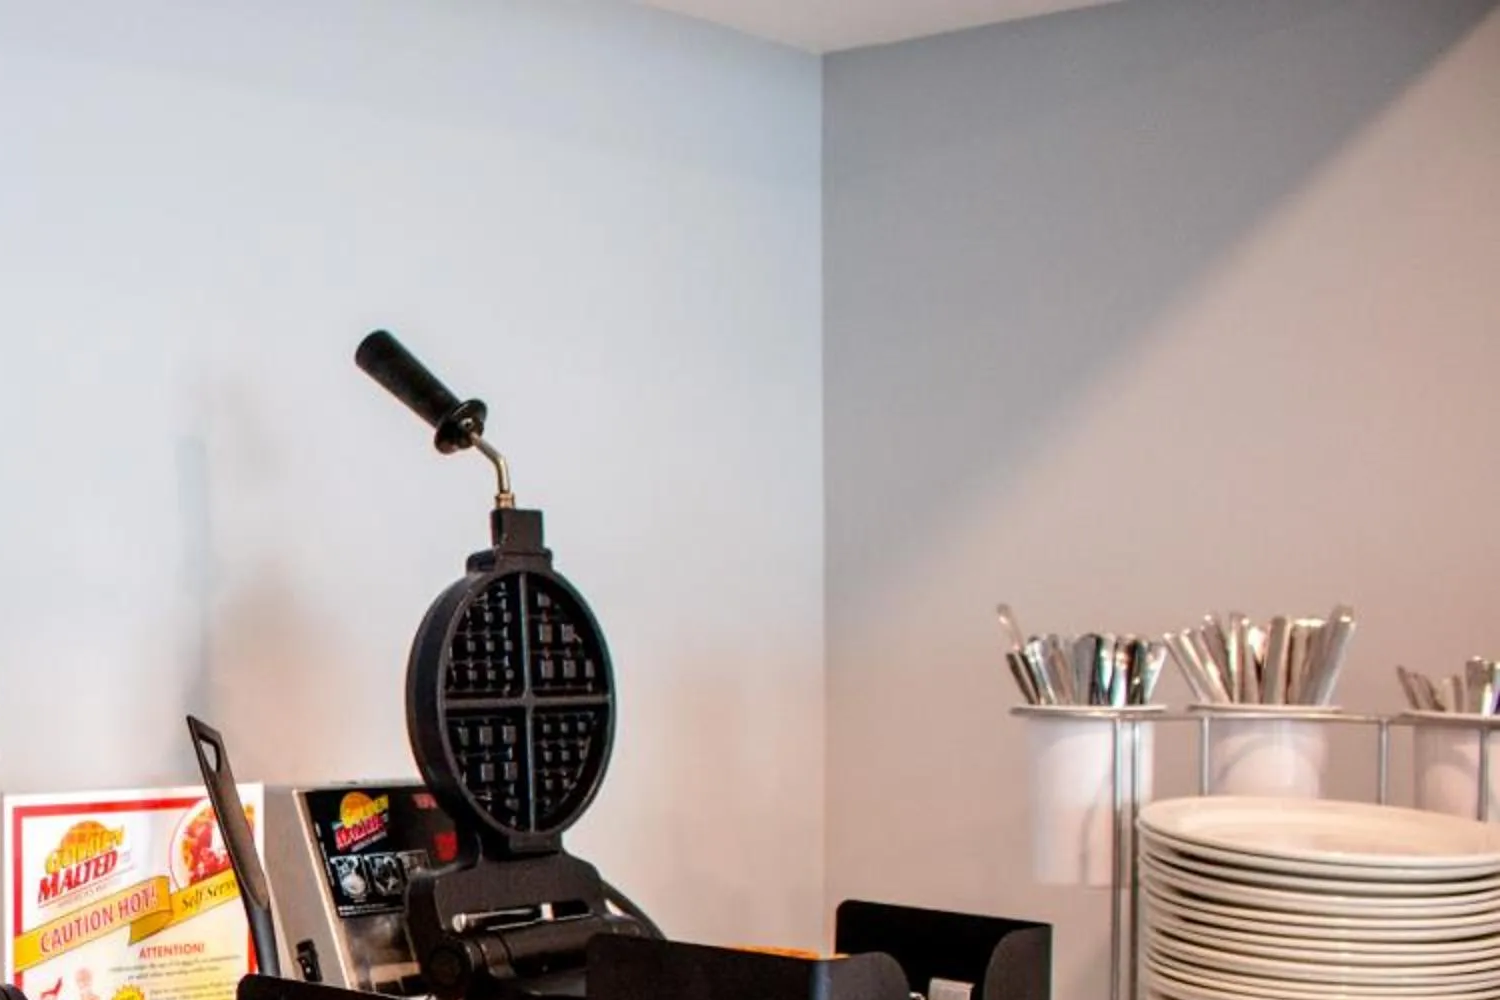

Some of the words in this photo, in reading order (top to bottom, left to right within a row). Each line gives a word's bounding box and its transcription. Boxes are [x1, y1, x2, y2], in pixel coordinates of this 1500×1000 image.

[37, 850, 118, 904] MALTED
[40, 907, 114, 954] CAUTION
[118, 887, 159, 925] HOT!
[139, 943, 205, 959] ATTENTION!
